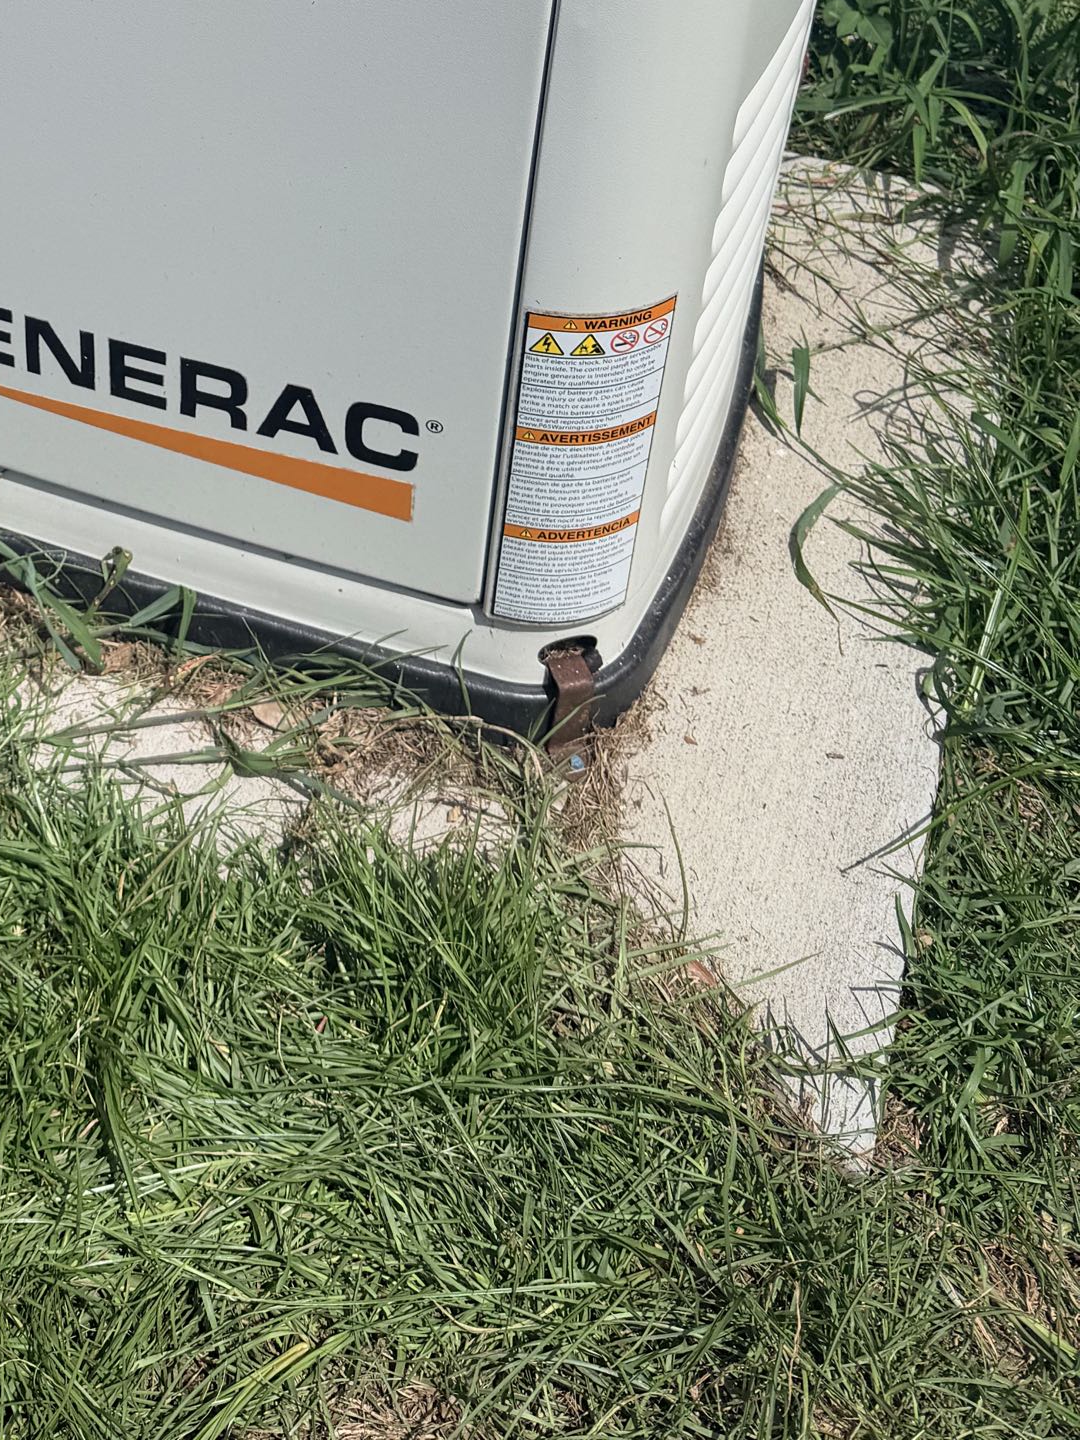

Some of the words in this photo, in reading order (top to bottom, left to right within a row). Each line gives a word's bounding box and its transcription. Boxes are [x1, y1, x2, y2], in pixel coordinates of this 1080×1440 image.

[585, 311, 652, 330] WARNING
[525, 354, 539, 362] Risk
[524, 361, 542, 370] parts
[584, 364, 609, 372] control
[523, 368, 548, 378] engine
[550, 372, 585, 380] generator
[594, 368, 625, 378] intended
[523, 375, 555, 385] operated
[600, 375, 622, 384] service
[522, 384, 556, 395] Explosion
[626, 379, 644, 388] cause
[521, 392, 544, 400] severe
[545, 394, 566, 403] injury
[521, 397, 539, 406] strike
[520, 404, 545, 415] vicinity
[519, 413, 543, 422] Cancer
[559, 416, 603, 425] reproductive
[540, 416, 653, 444] AVERTISSEMENT
[537, 518, 631, 540] ADVERTENCIA
